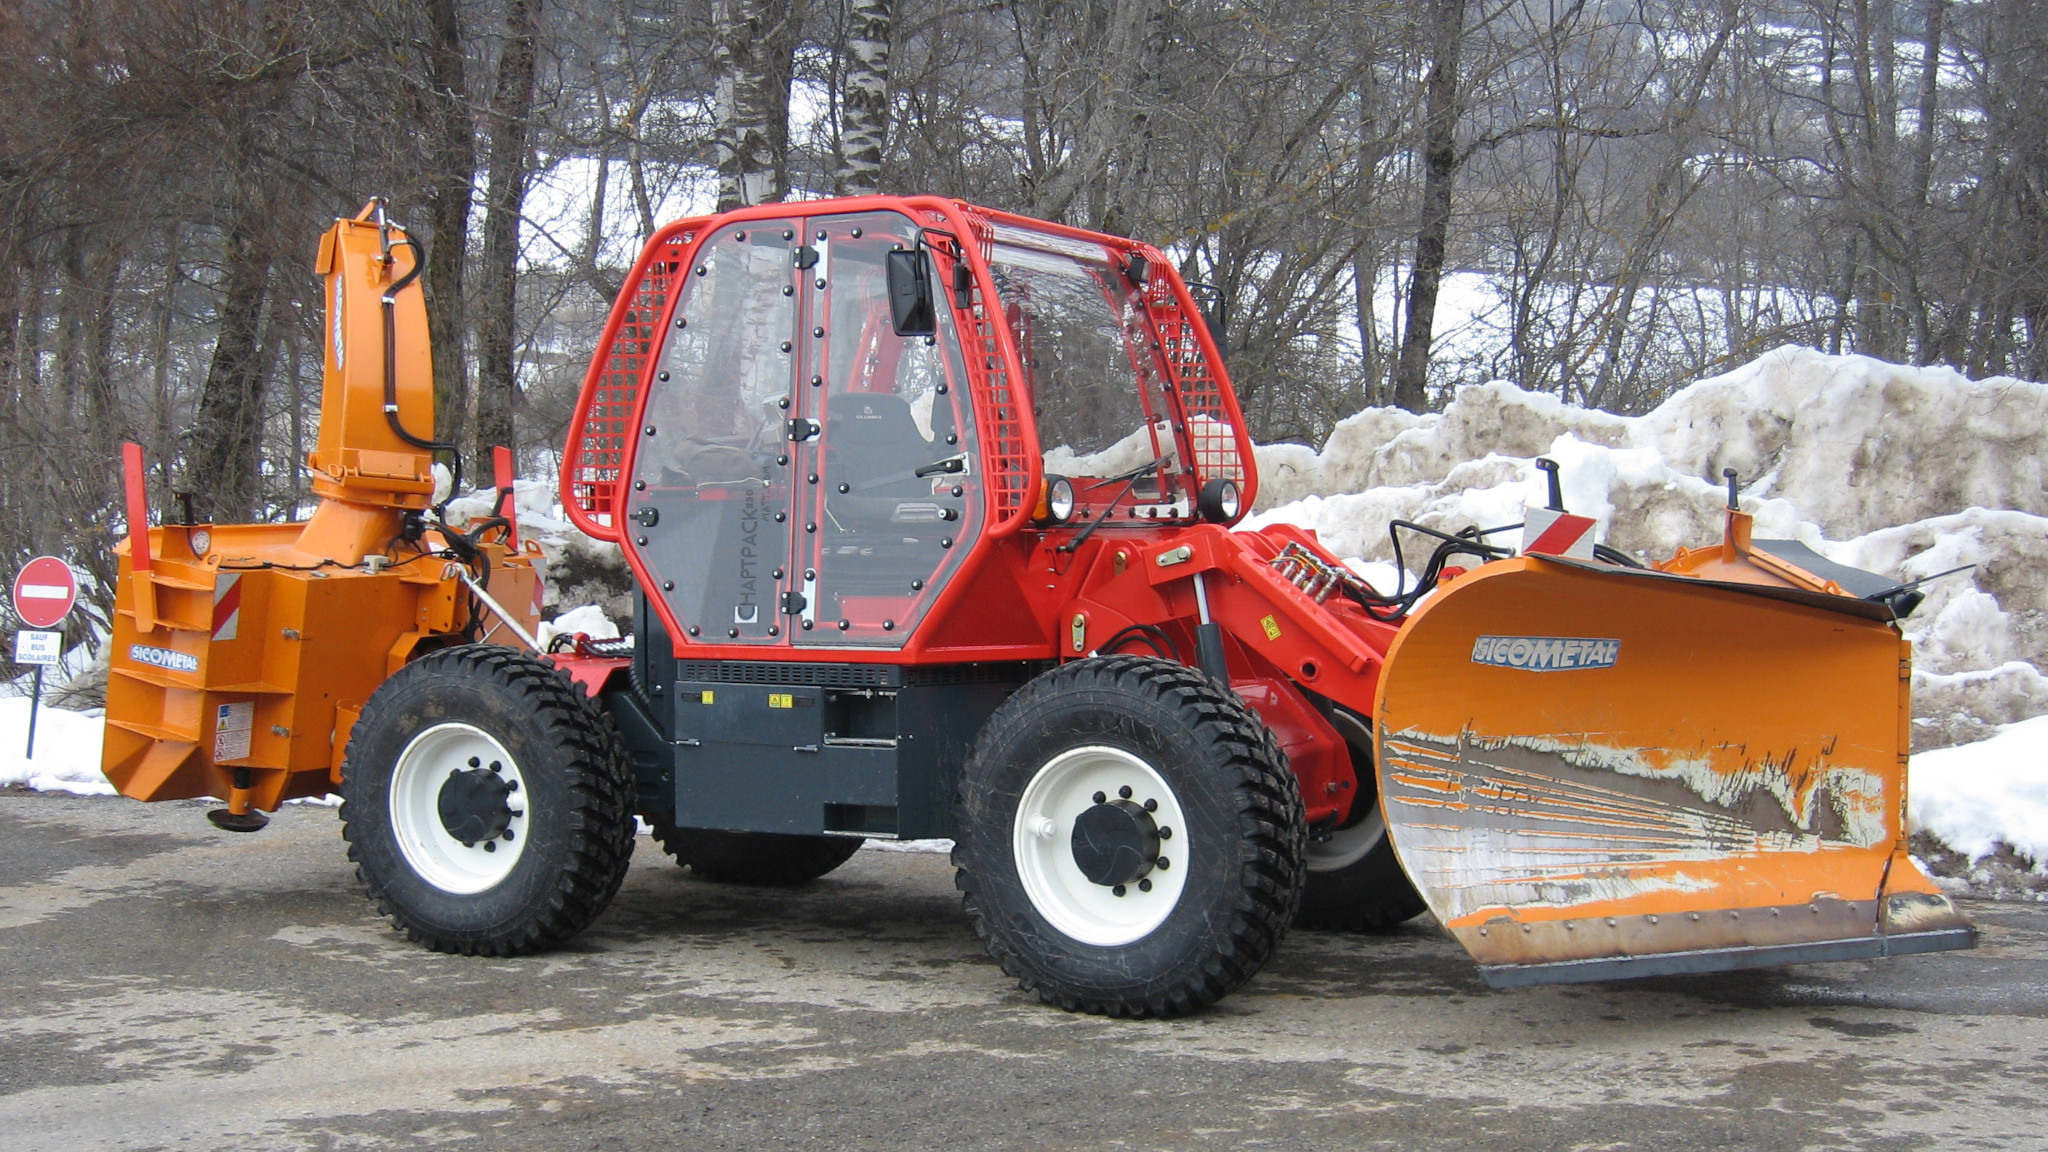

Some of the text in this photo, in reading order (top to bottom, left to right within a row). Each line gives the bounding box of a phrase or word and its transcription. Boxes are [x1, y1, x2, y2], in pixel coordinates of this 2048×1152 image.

[30, 633, 48, 641] SAUF
[17, 653, 57, 662] SCOLAIRES
[132, 646, 198, 670] SICOMETAL
[1474, 637, 1618, 669] SICOMETAL
